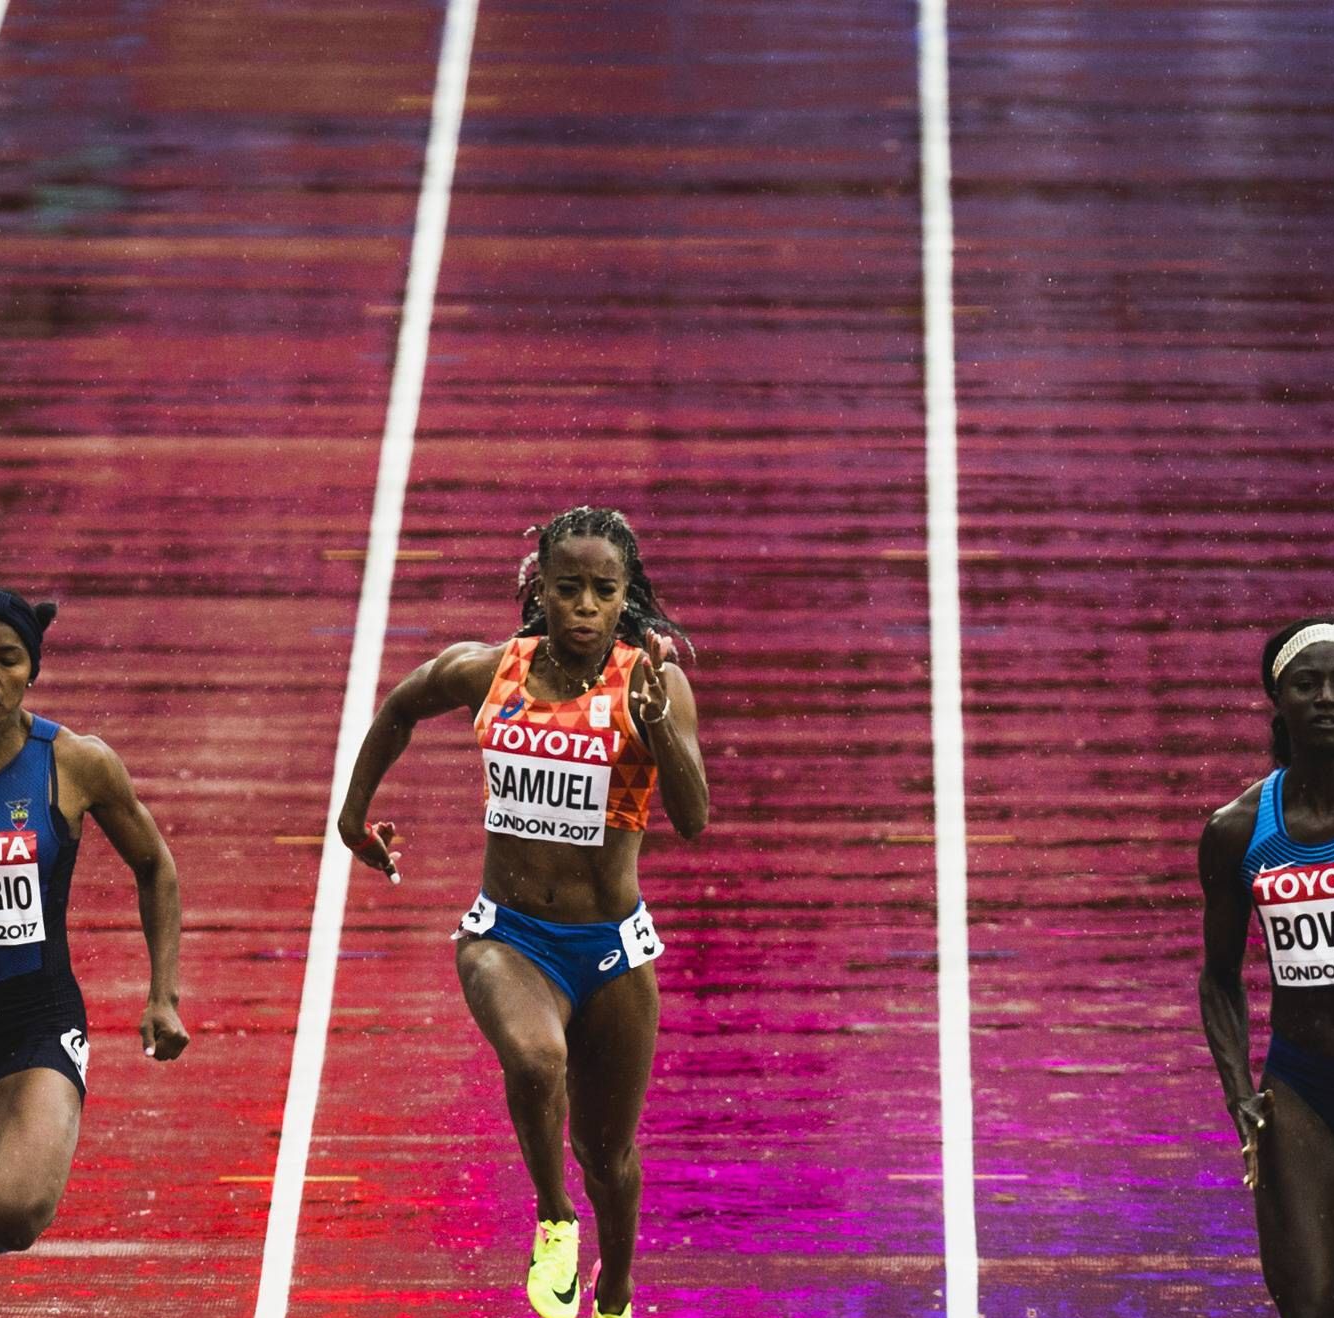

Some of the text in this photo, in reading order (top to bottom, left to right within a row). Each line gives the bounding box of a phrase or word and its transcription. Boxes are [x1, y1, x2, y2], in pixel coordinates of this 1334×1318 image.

[491, 722, 609, 762] TOYOTA
[489, 761, 599, 812] SAMUEL
[488, 809, 600, 841] LONDON 2017
